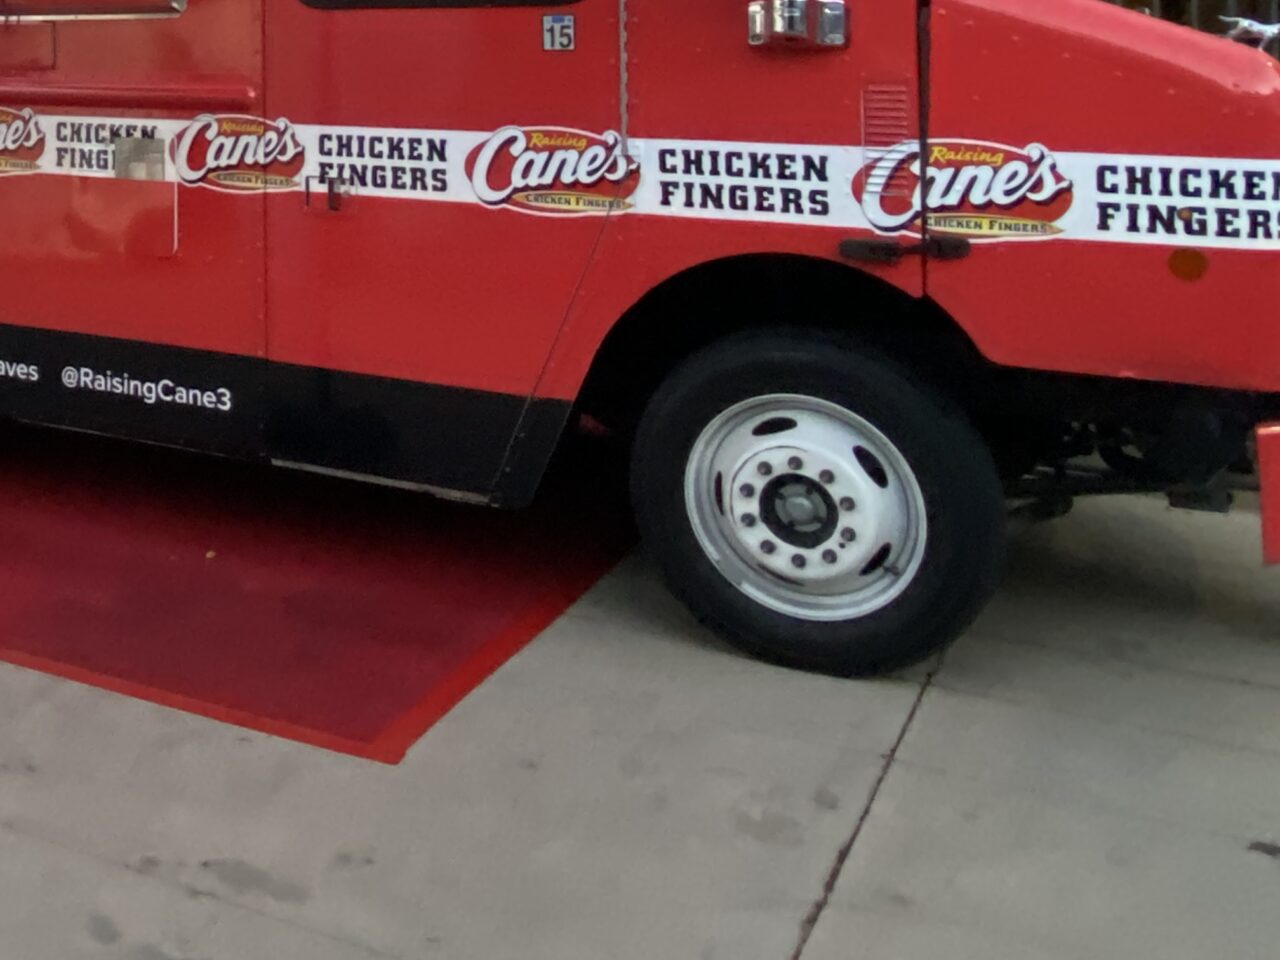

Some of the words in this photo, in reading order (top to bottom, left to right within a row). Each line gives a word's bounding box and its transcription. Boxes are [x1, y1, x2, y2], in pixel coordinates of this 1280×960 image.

[545, 25, 573, 49] 15
[174, 114, 303, 185] Cane's
[318, 134, 448, 162] CHICKEN
[529, 132, 587, 150] Raising
[56, 147, 116, 170] FING
[472, 126, 641, 204] Cane's
[658, 148, 830, 182] CHICKEN
[929, 146, 1004, 167] Raising
[318, 162, 448, 192] FINGERS
[660, 181, 830, 216] FINGERS
[988, 219, 1048, 234] FINGERS
[1096, 202, 1280, 239] FINGER
[61, 365, 232, 411] @RaisingCane3
